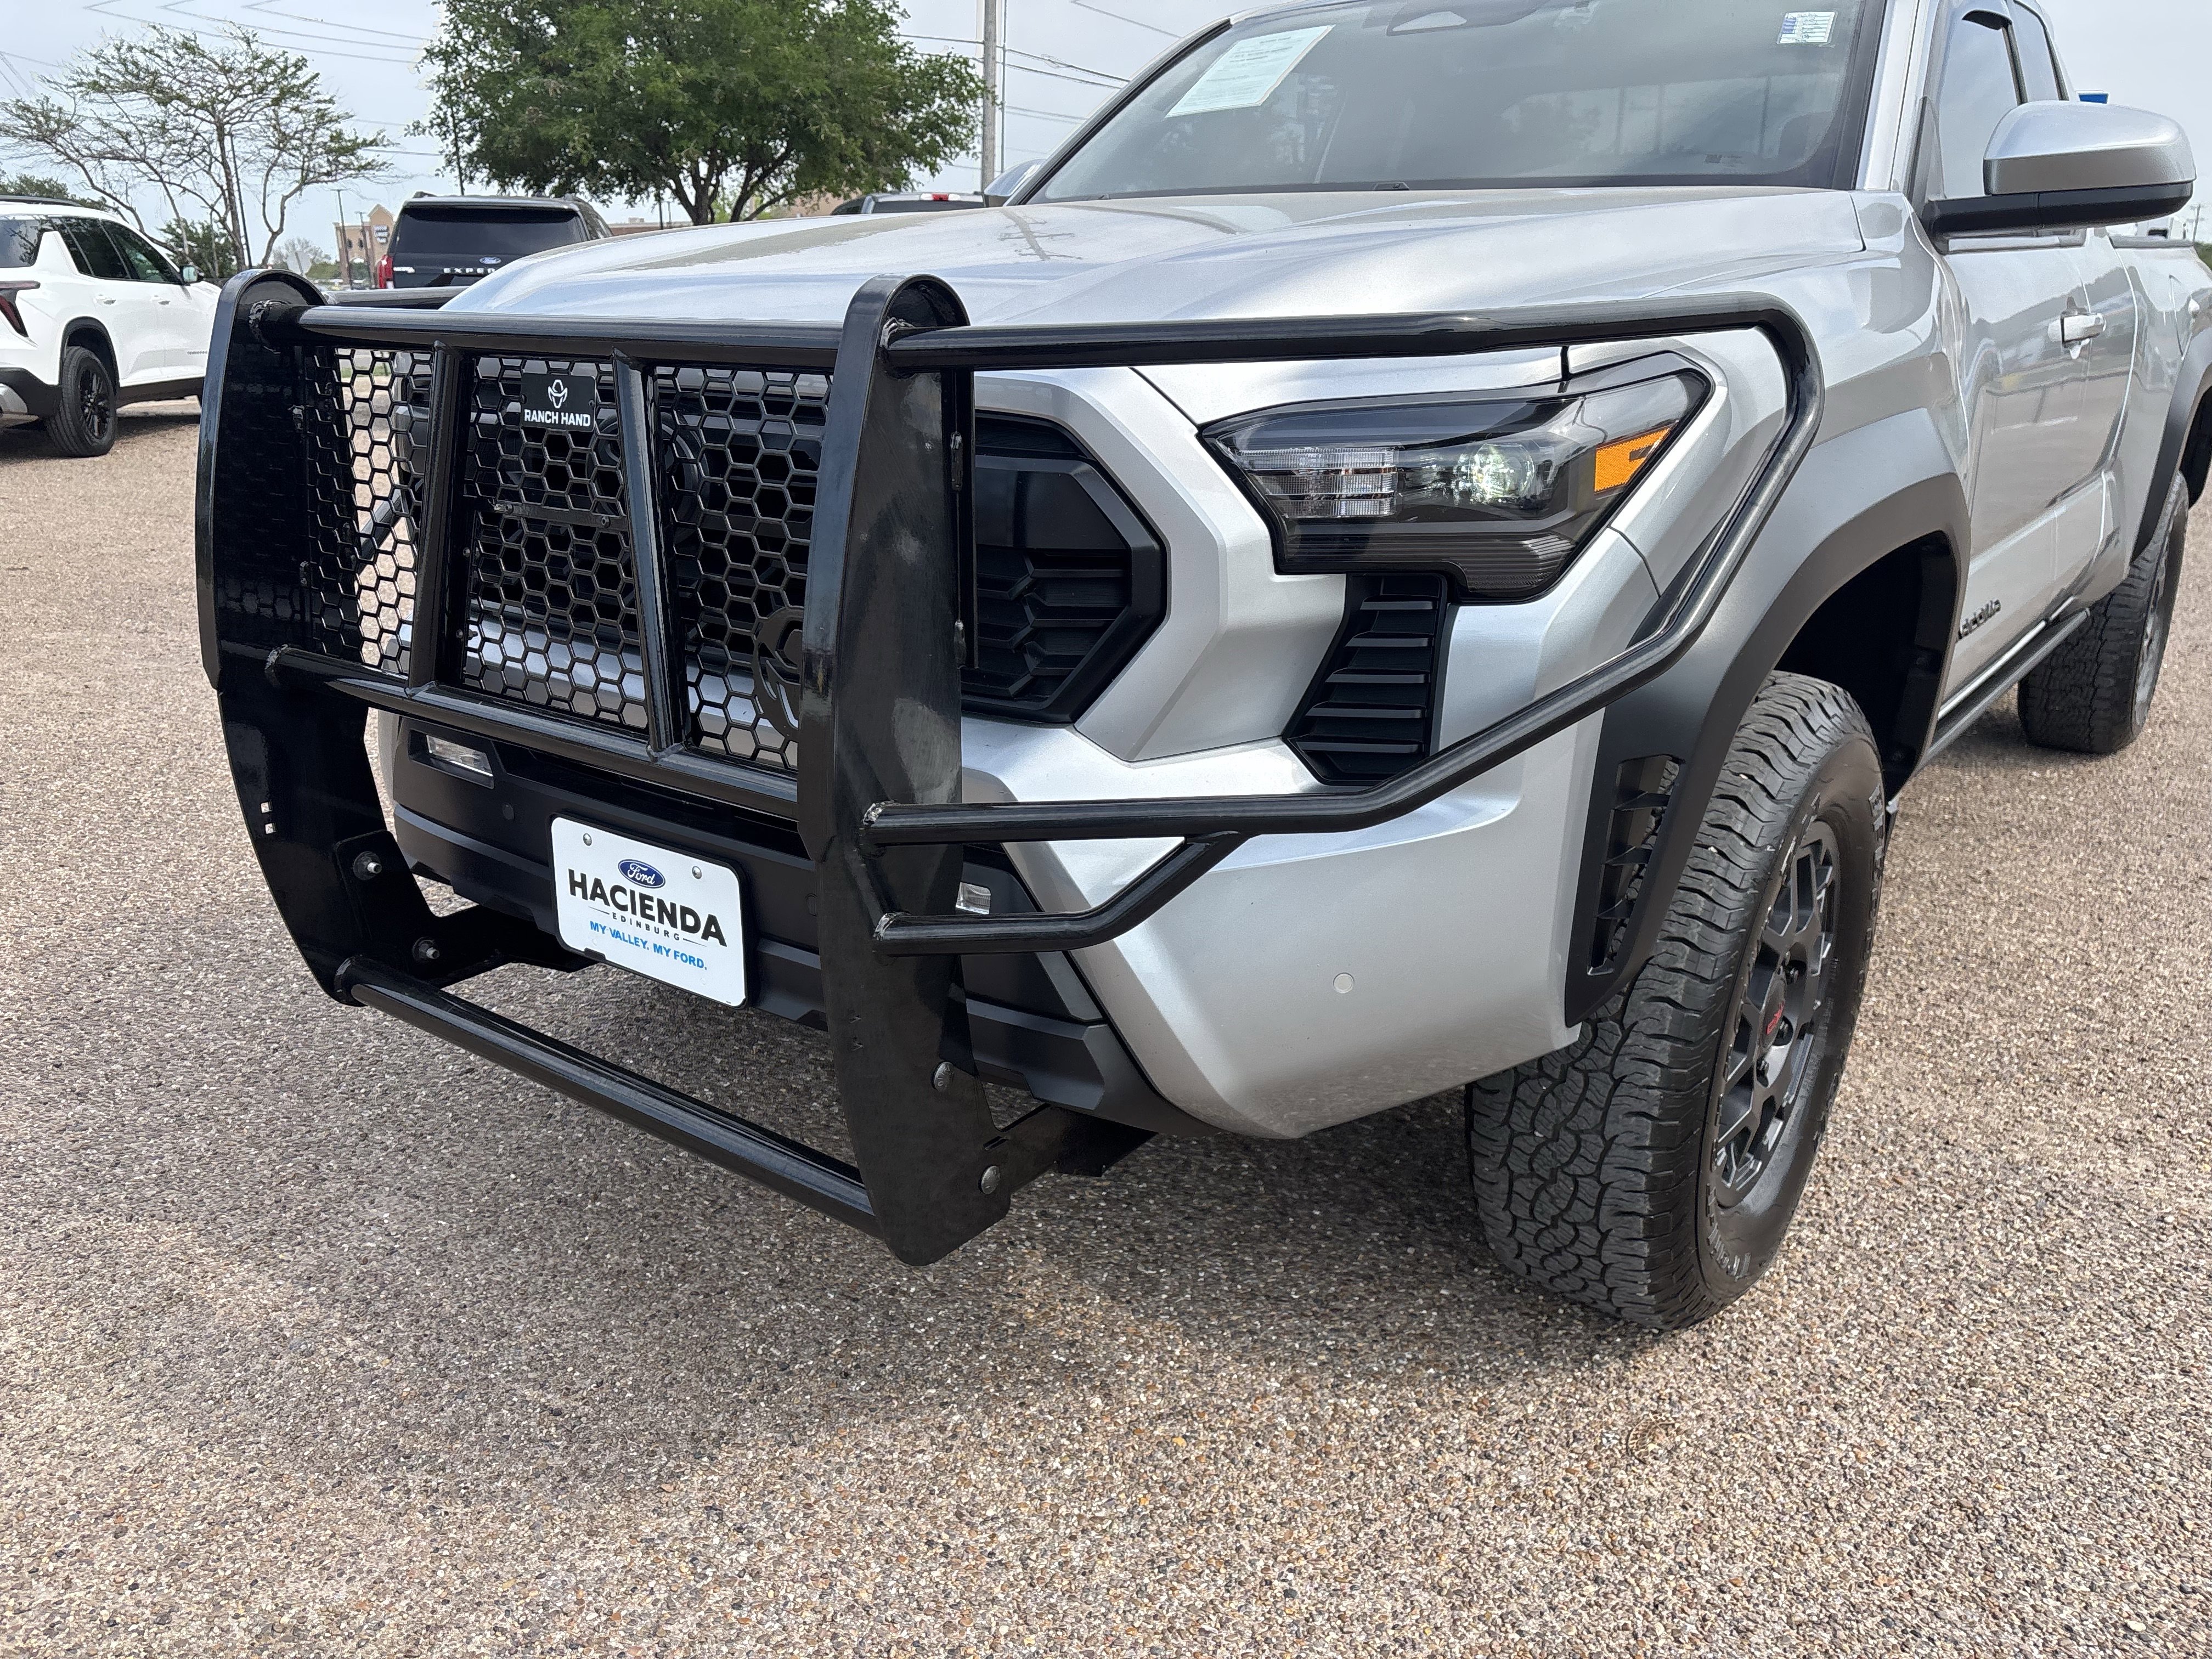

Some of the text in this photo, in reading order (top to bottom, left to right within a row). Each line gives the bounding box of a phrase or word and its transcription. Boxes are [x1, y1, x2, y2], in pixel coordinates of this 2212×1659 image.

[524, 409, 591, 427] RANCH HAND
[627, 863, 656, 885] Ford
[568, 868, 727, 947] HACIENDA
[612, 912, 680, 941] EDINBURG
[590, 921, 708, 970] MY VALLEY. MY FORD.
